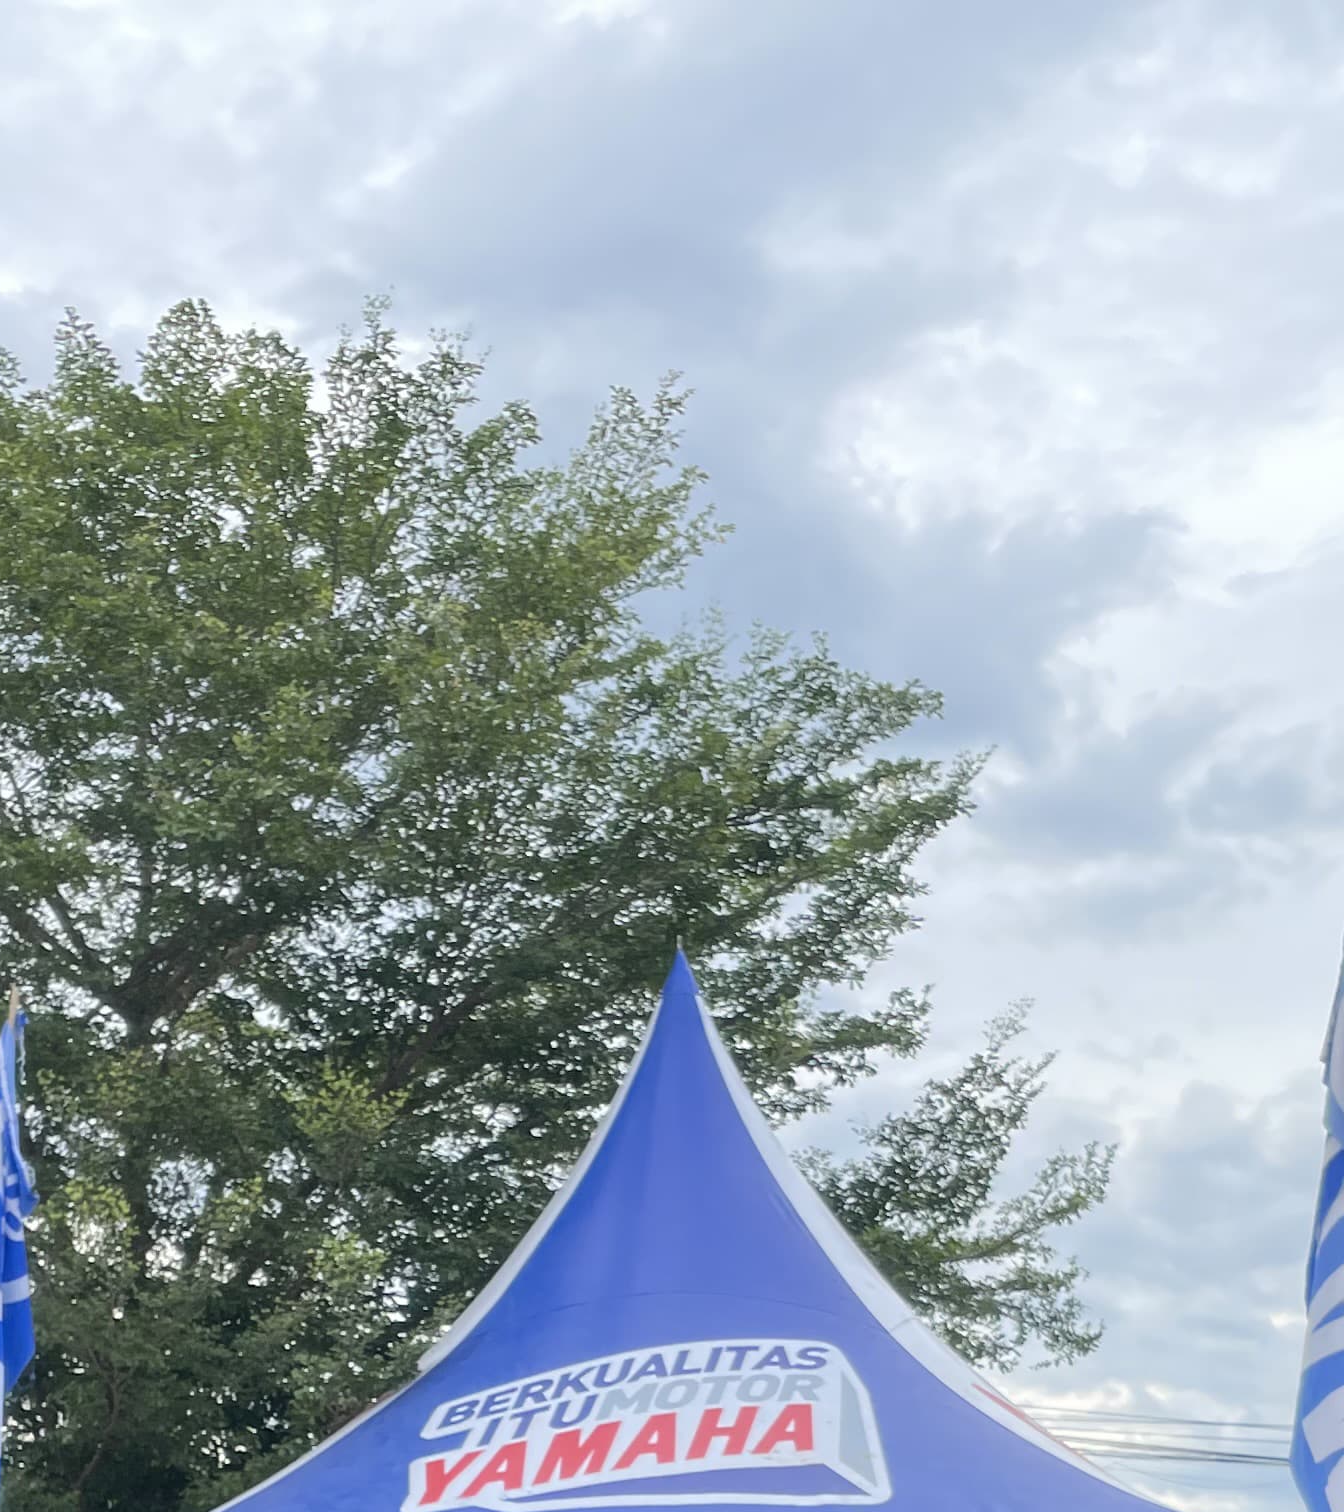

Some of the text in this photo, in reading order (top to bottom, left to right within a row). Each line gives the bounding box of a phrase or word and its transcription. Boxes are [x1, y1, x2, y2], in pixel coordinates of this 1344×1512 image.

[437, 1345, 829, 1430] BERKUALITAS
[468, 1373, 827, 1448] ITU MOTOR
[418, 1403, 814, 1506] YAMAHA
